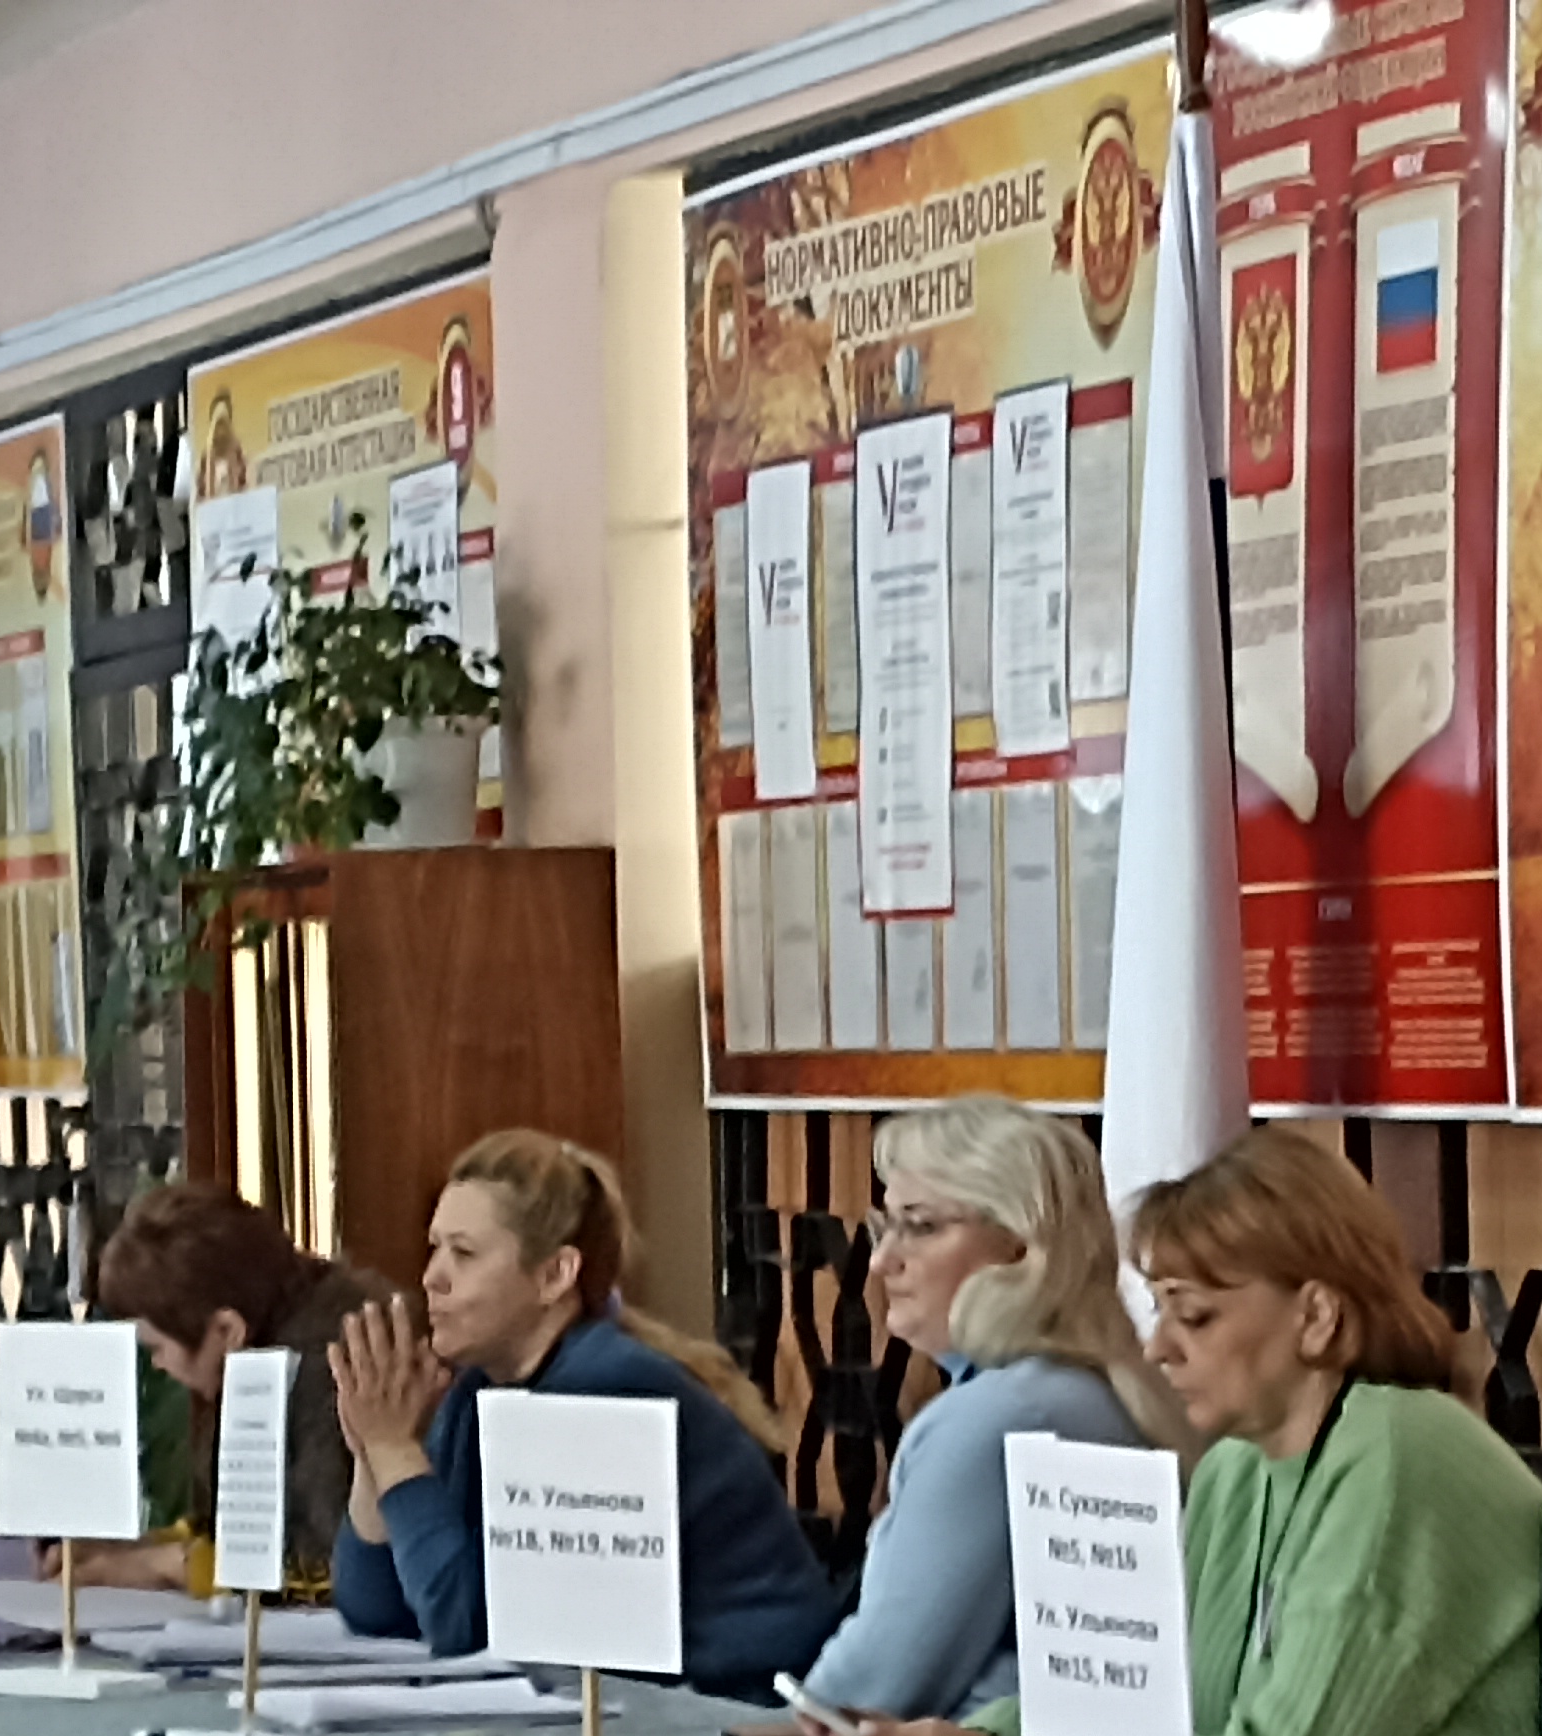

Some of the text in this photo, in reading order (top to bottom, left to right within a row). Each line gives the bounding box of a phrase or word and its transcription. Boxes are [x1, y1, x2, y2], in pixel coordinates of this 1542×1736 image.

[766, 167, 1047, 297] НОРМАТИВНО-ПРАВОВЫЕ
[835, 257, 974, 341] ДОКУМЕНТЫ
[504, 1484, 645, 1512] Ул. Ульянова
[1026, 1483, 1158, 1524] Ул. Сукаренко
[487, 1526, 665, 1558] №18, №19, №20
[1048, 1537, 1138, 1571] №5, №16
[1034, 1601, 1159, 1641] Ул. Ульянова
[1047, 1653, 1148, 1689] №15, №17
